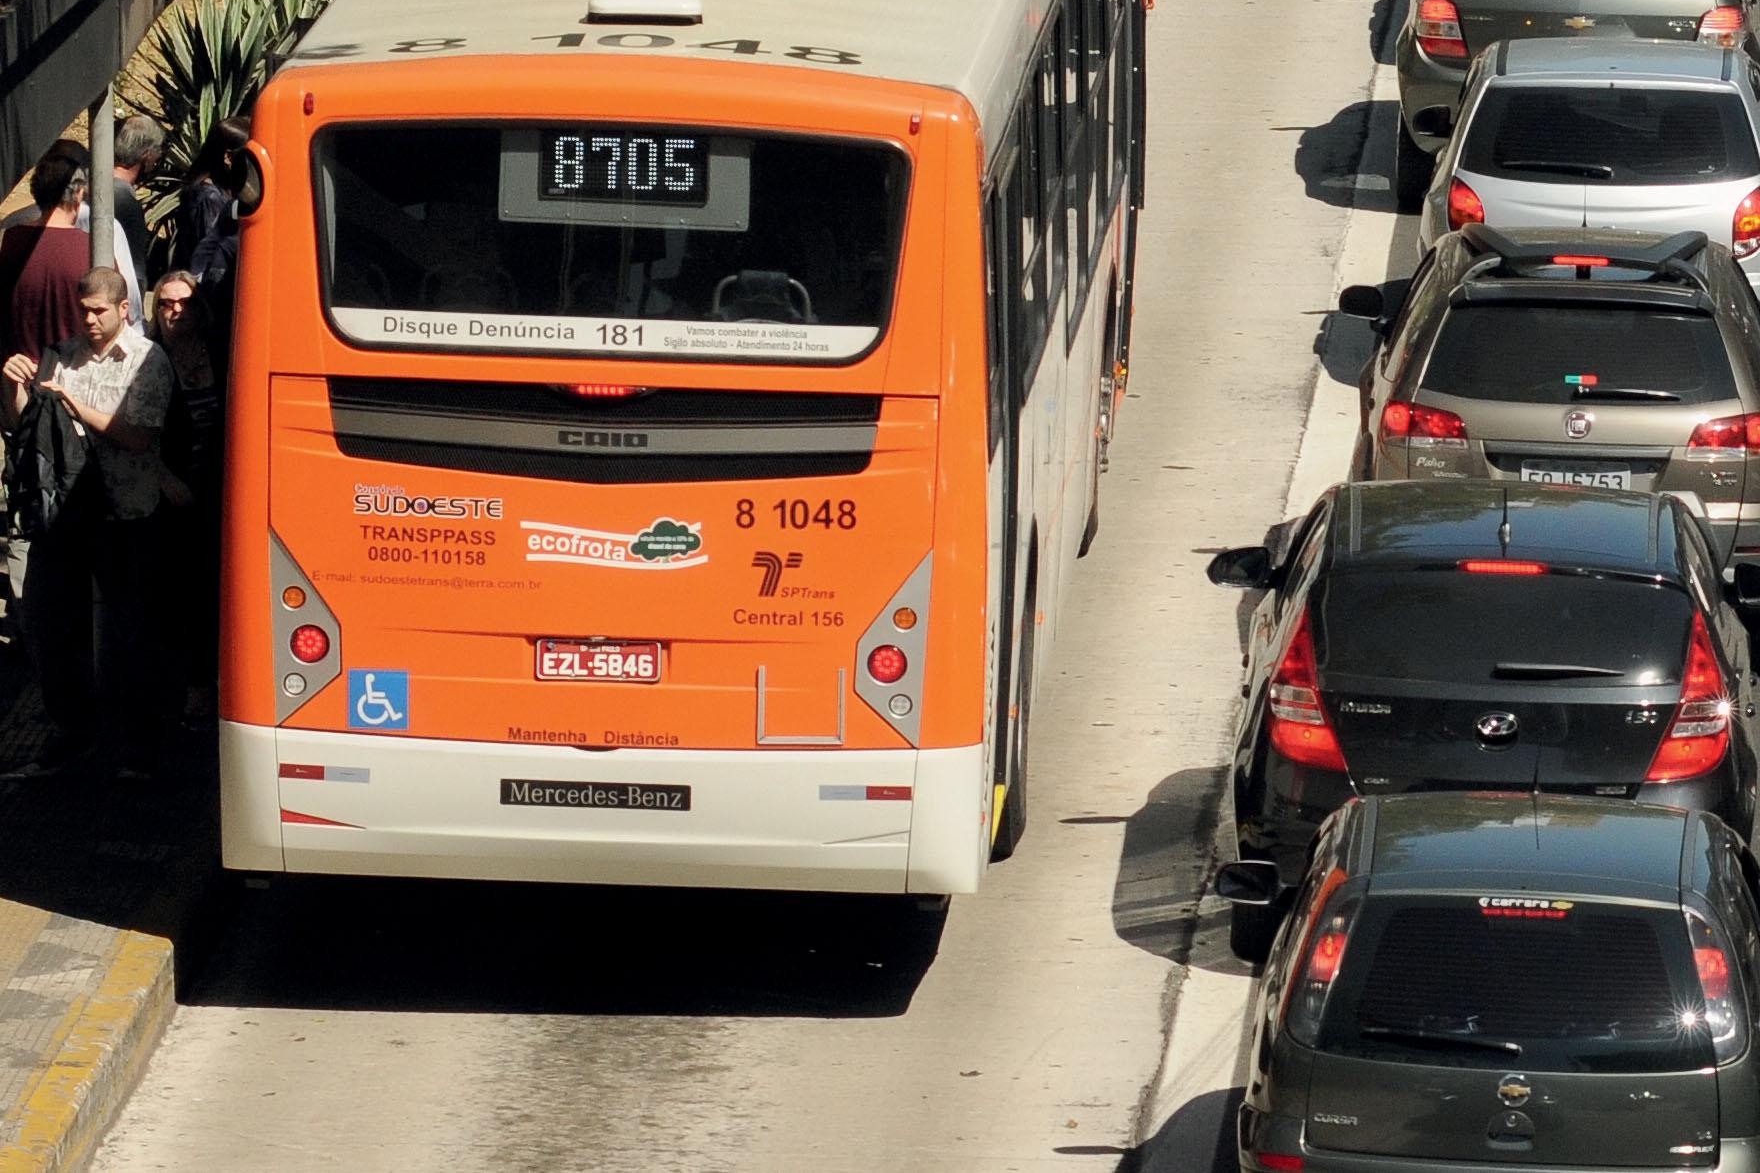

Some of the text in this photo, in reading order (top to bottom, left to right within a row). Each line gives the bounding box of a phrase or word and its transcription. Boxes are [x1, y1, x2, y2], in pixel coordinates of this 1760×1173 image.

[531, 33, 863, 65] 1048
[555, 136, 695, 191] 8705
[383, 316, 644, 346] Disque Denúncia 181
[686, 326, 715, 336] Vamos
[718, 327, 759, 337] combater
[664, 336, 688, 349] Sigilo
[690, 337, 728, 348] absoluto
[736, 340, 790, 350] Atendimento
[792, 341, 803, 350] 24
[805, 343, 829, 352] horas
[354, 493, 503, 519] SUDOESTE
[736, 498, 857, 530] 8 1048
[360, 525, 497, 546] TRANSPPASS
[368, 546, 486, 566] 0800-110158
[527, 534, 626, 561] ecofrota
[780, 587, 835, 599] SPTrans
[733, 608, 844, 627] Central 156
[543, 653, 654, 676] EZL-5846
[508, 727, 680, 746] Mantenha Distância
[510, 782, 682, 808] Mercedes-Benz
